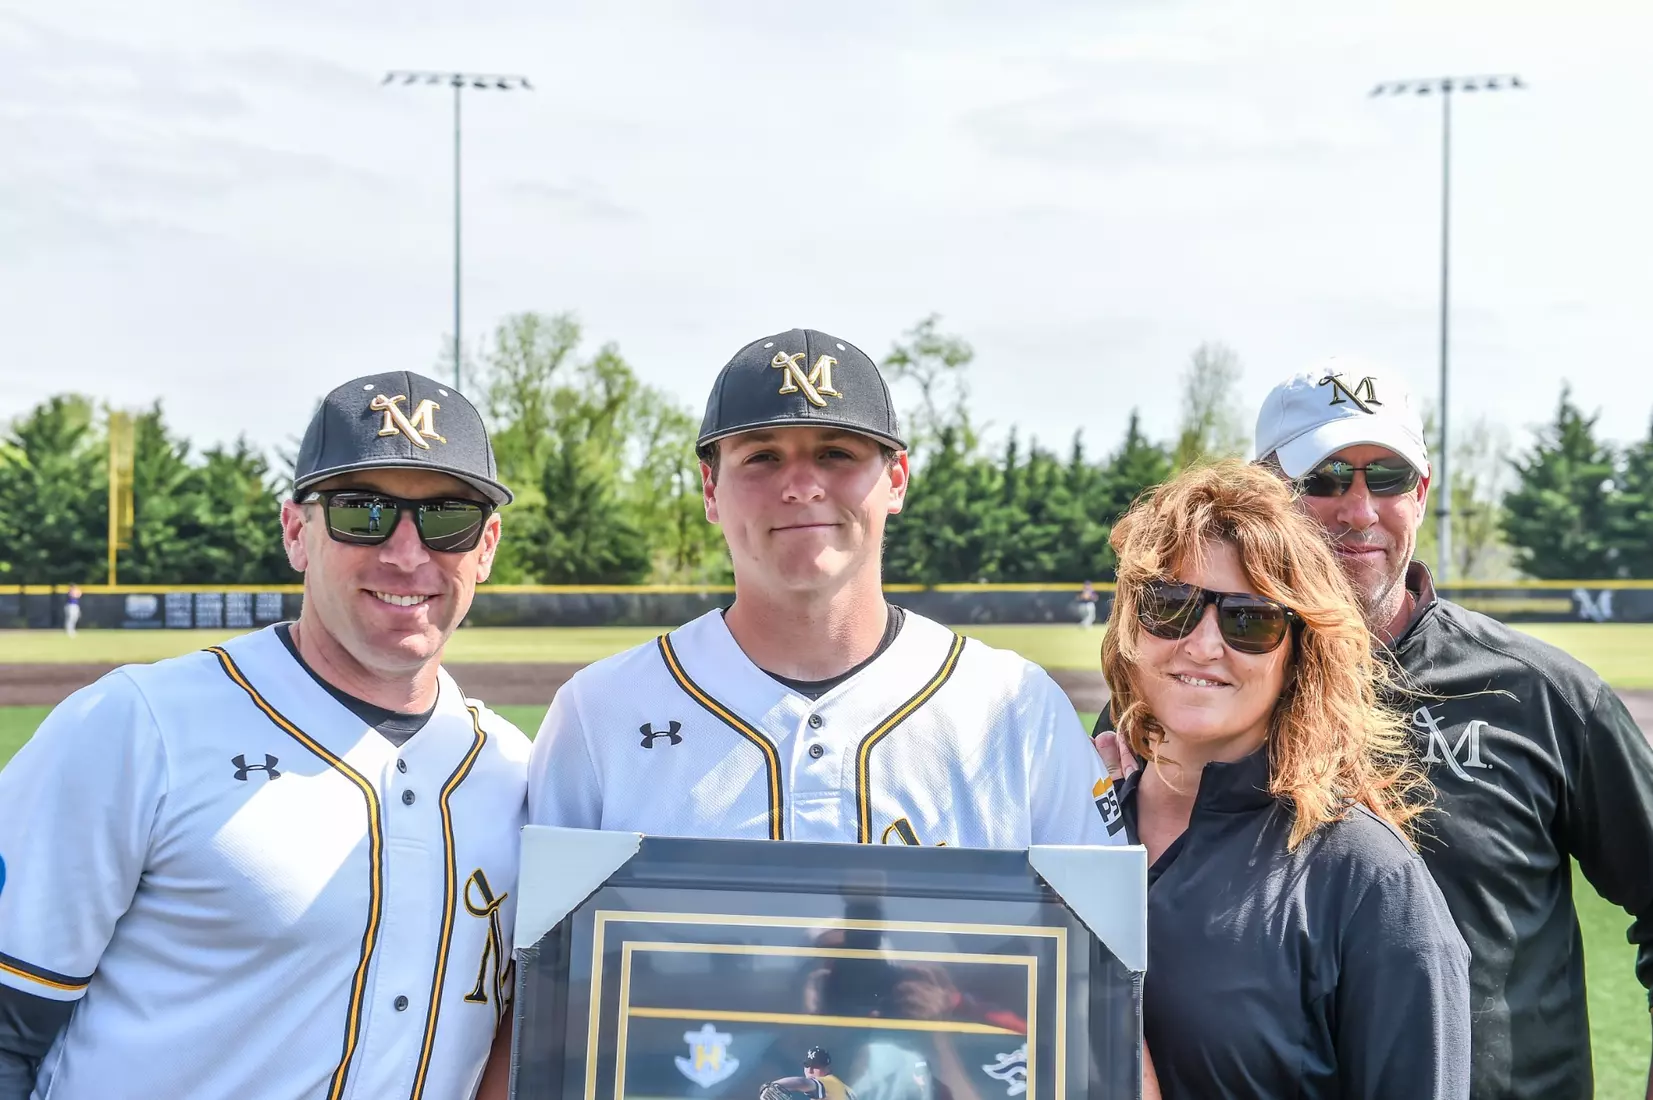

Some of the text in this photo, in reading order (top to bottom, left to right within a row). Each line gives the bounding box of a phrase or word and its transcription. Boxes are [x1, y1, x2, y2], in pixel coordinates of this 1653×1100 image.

[771, 351, 838, 407] M
[1319, 373, 1383, 415] M
[370, 394, 441, 450] M
[1413, 706, 1489, 782] M
